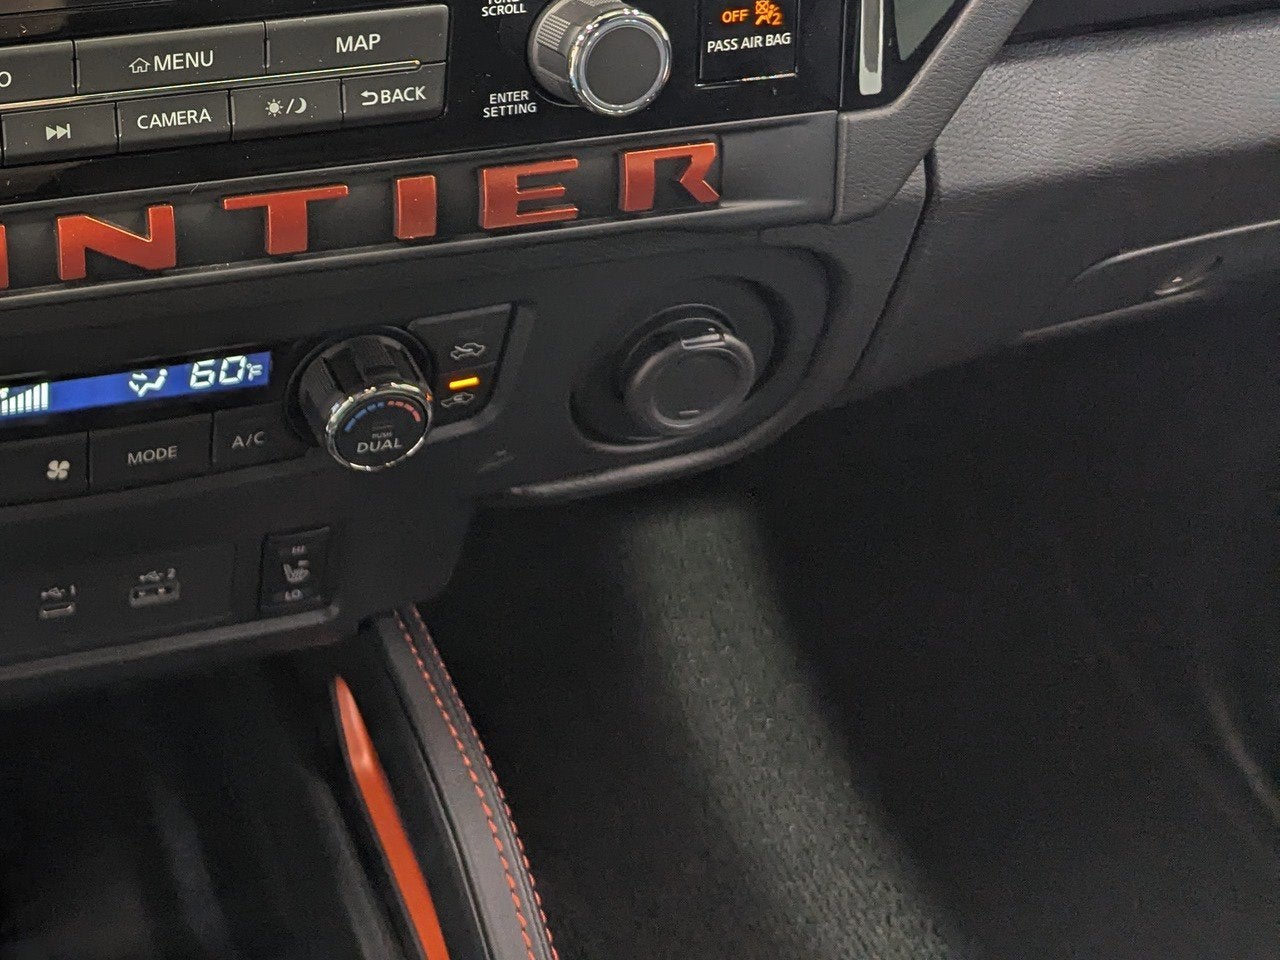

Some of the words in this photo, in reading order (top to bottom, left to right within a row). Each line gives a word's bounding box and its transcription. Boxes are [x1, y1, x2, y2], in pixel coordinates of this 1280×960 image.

[481, 3, 527, 17] SCROLL
[721, 8, 749, 23] OFF
[335, 33, 381, 54] MAP
[707, 37, 738, 53] PASS
[740, 35, 764, 50] AIR
[766, 32, 792, 47] BAG
[153, 50, 214, 72] MENU
[380, 85, 426, 105] BACK
[489, 90, 529, 105] ENTER
[136, 107, 211, 131] CAMERA
[483, 102, 537, 118] SETTING
[231, 431, 265, 450] A/C
[357, 438, 402, 453] DUAL
[127, 445, 179, 466] MODE
